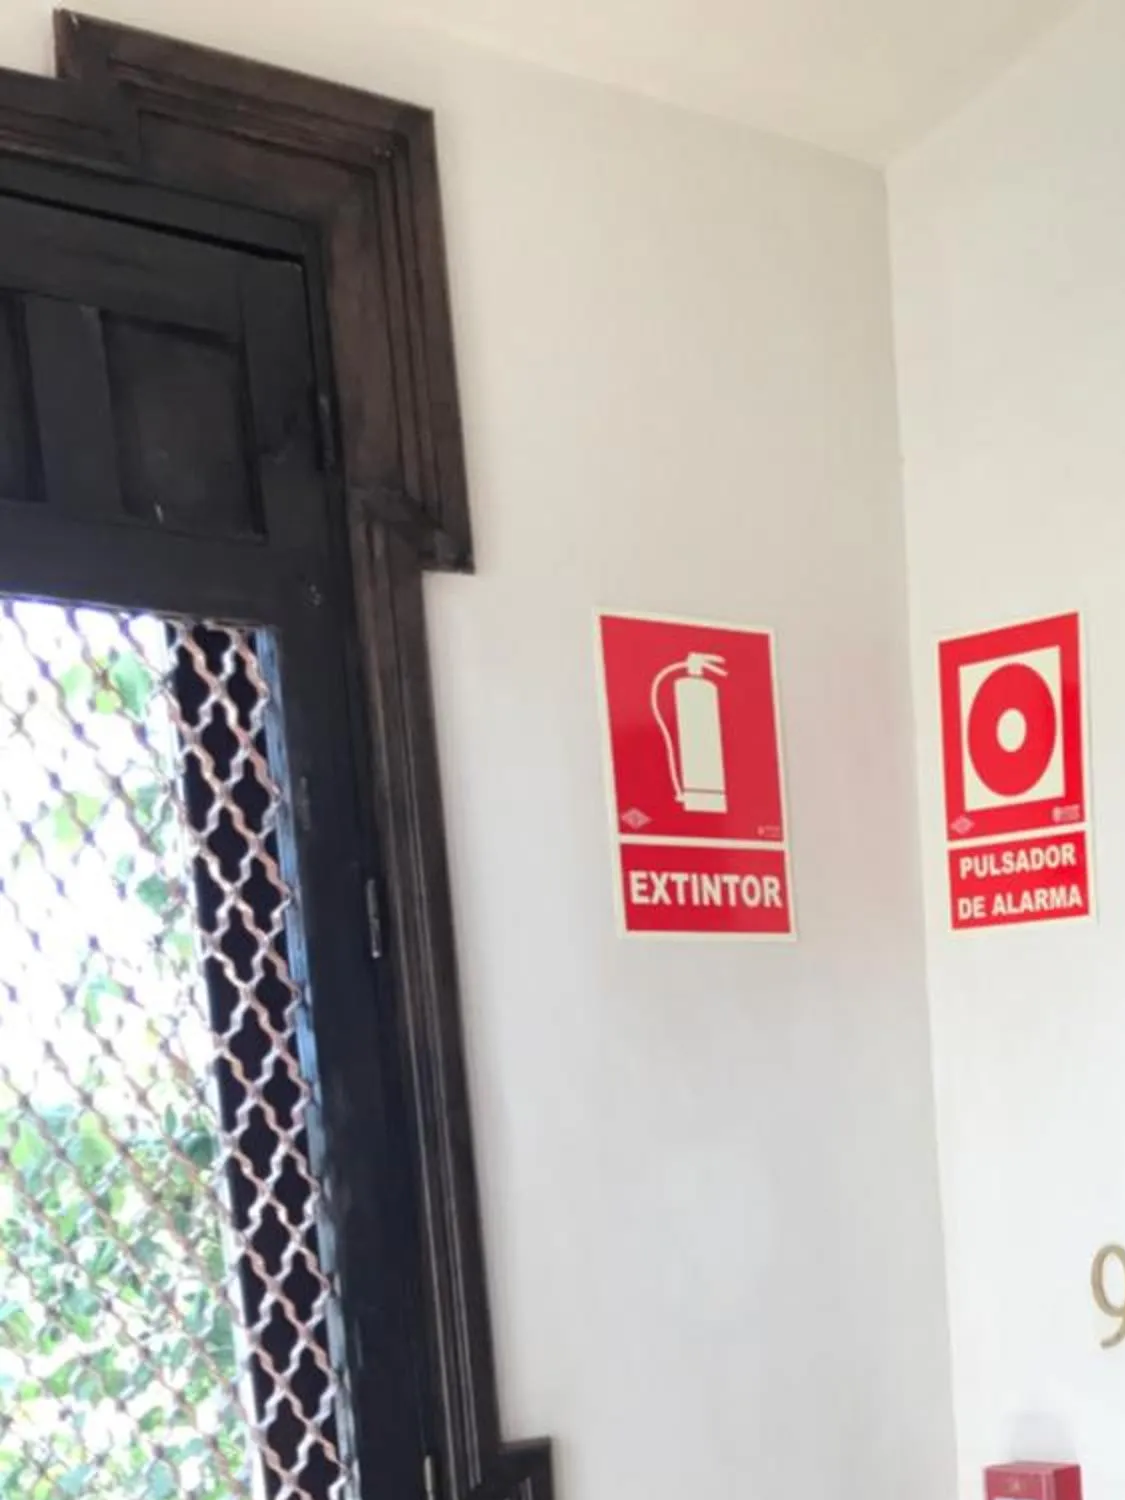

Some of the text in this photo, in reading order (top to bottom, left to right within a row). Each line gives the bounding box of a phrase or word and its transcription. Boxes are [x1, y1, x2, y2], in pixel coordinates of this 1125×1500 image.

[959, 843, 1076, 879] PULSADOR
[629, 870, 783, 909] EXTINTOR
[958, 884, 1082, 920] DE ALARMA
